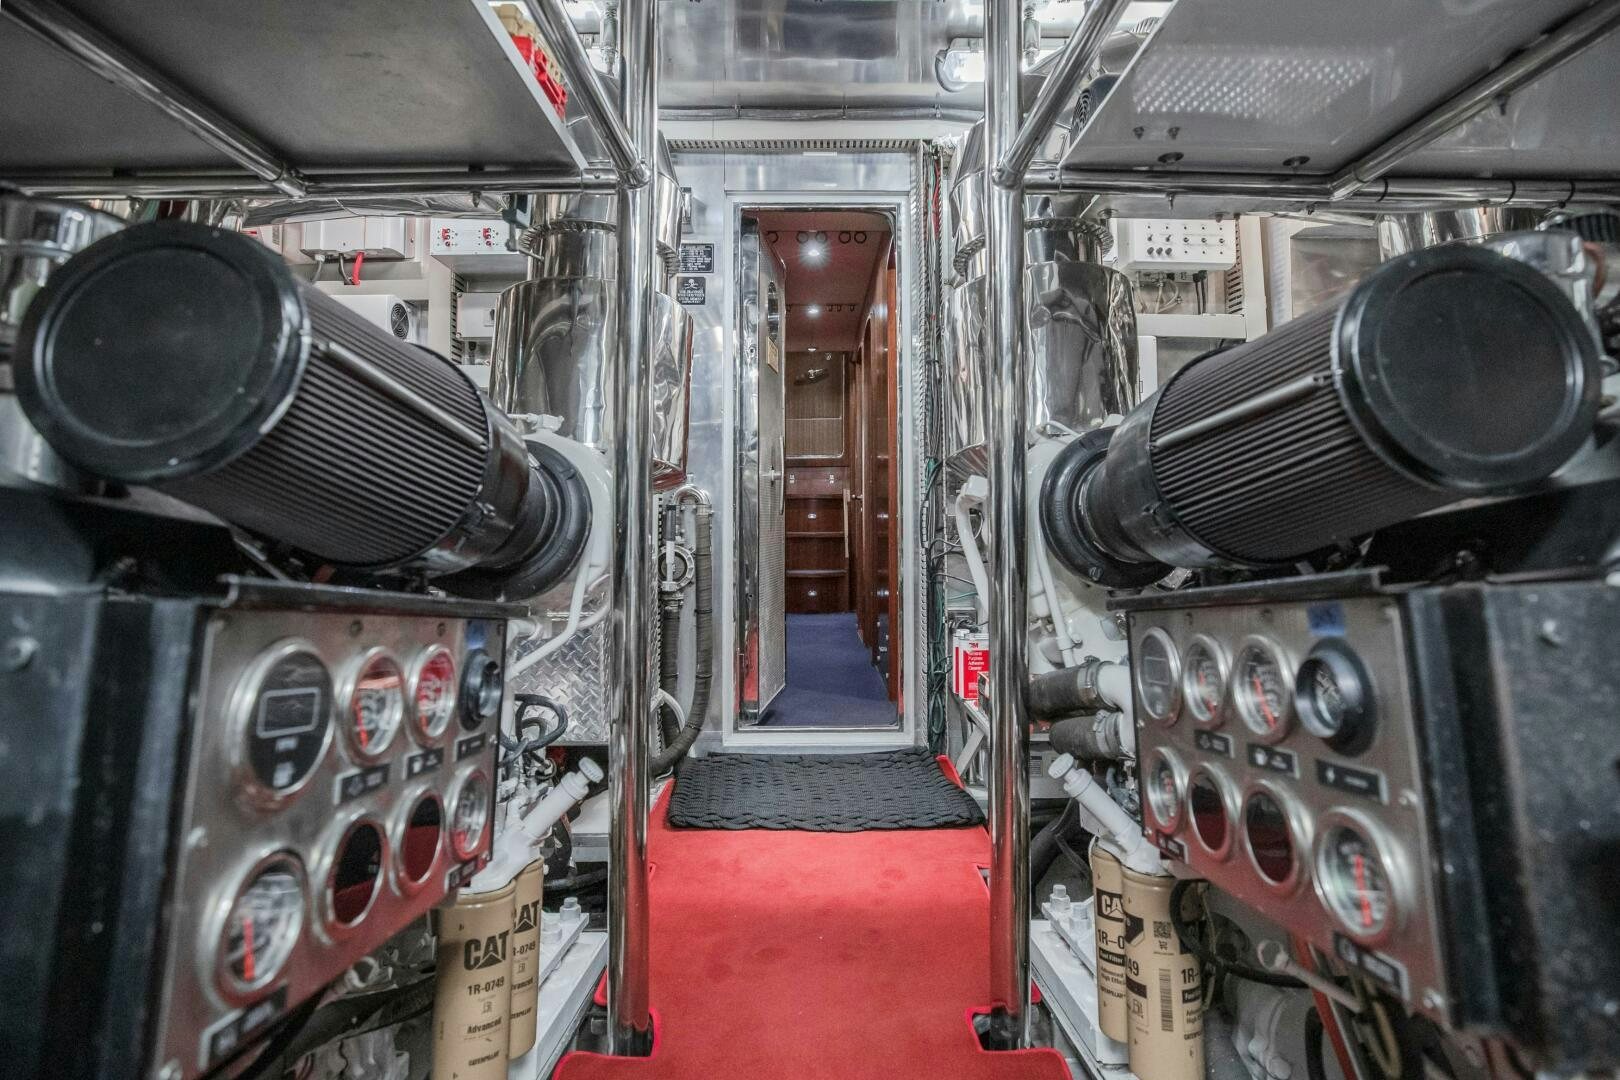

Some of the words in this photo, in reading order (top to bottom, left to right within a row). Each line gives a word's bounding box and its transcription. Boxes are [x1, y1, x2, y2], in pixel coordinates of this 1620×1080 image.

[513, 900, 539, 934] AT
[464, 930, 509, 970] CAT
[467, 976, 504, 996] 1R-0749
[467, 1016, 502, 1034] Advanced
